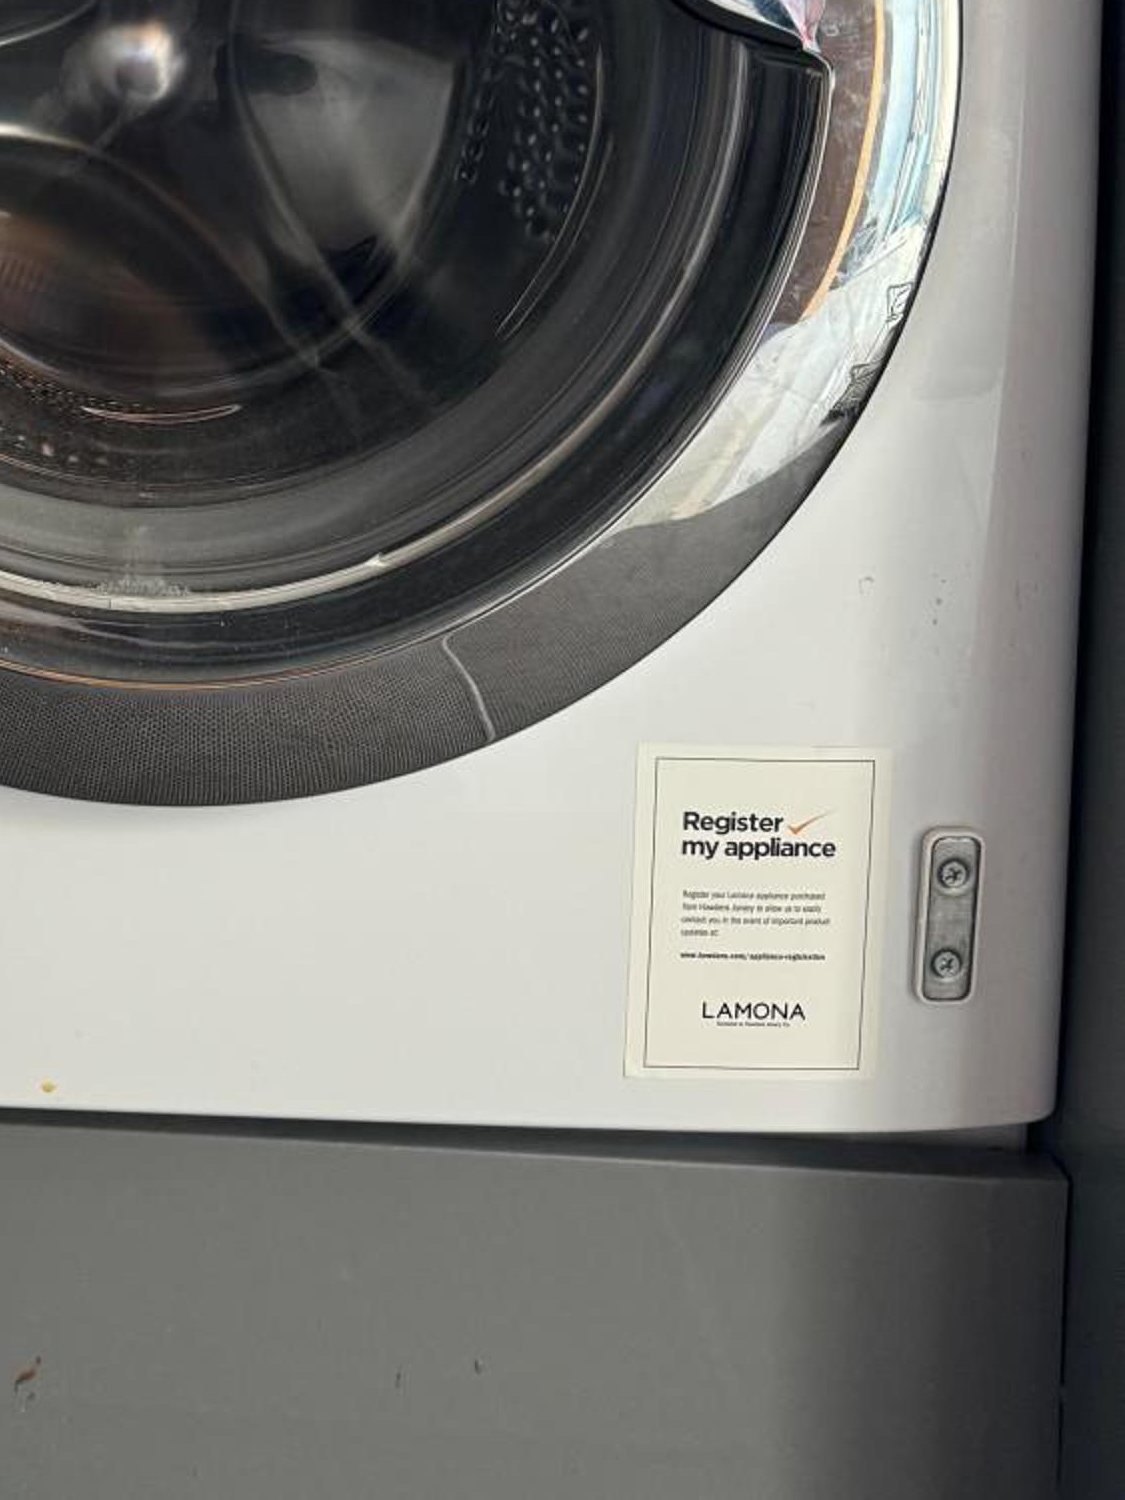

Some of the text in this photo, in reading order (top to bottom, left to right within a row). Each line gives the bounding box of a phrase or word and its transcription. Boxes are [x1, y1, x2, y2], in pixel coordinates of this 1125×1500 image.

[682, 811, 784, 835] Register
[681, 837, 837, 861] my appliance
[756, 891, 789, 901] appliance
[701, 1001, 806, 1020] LAMONA
